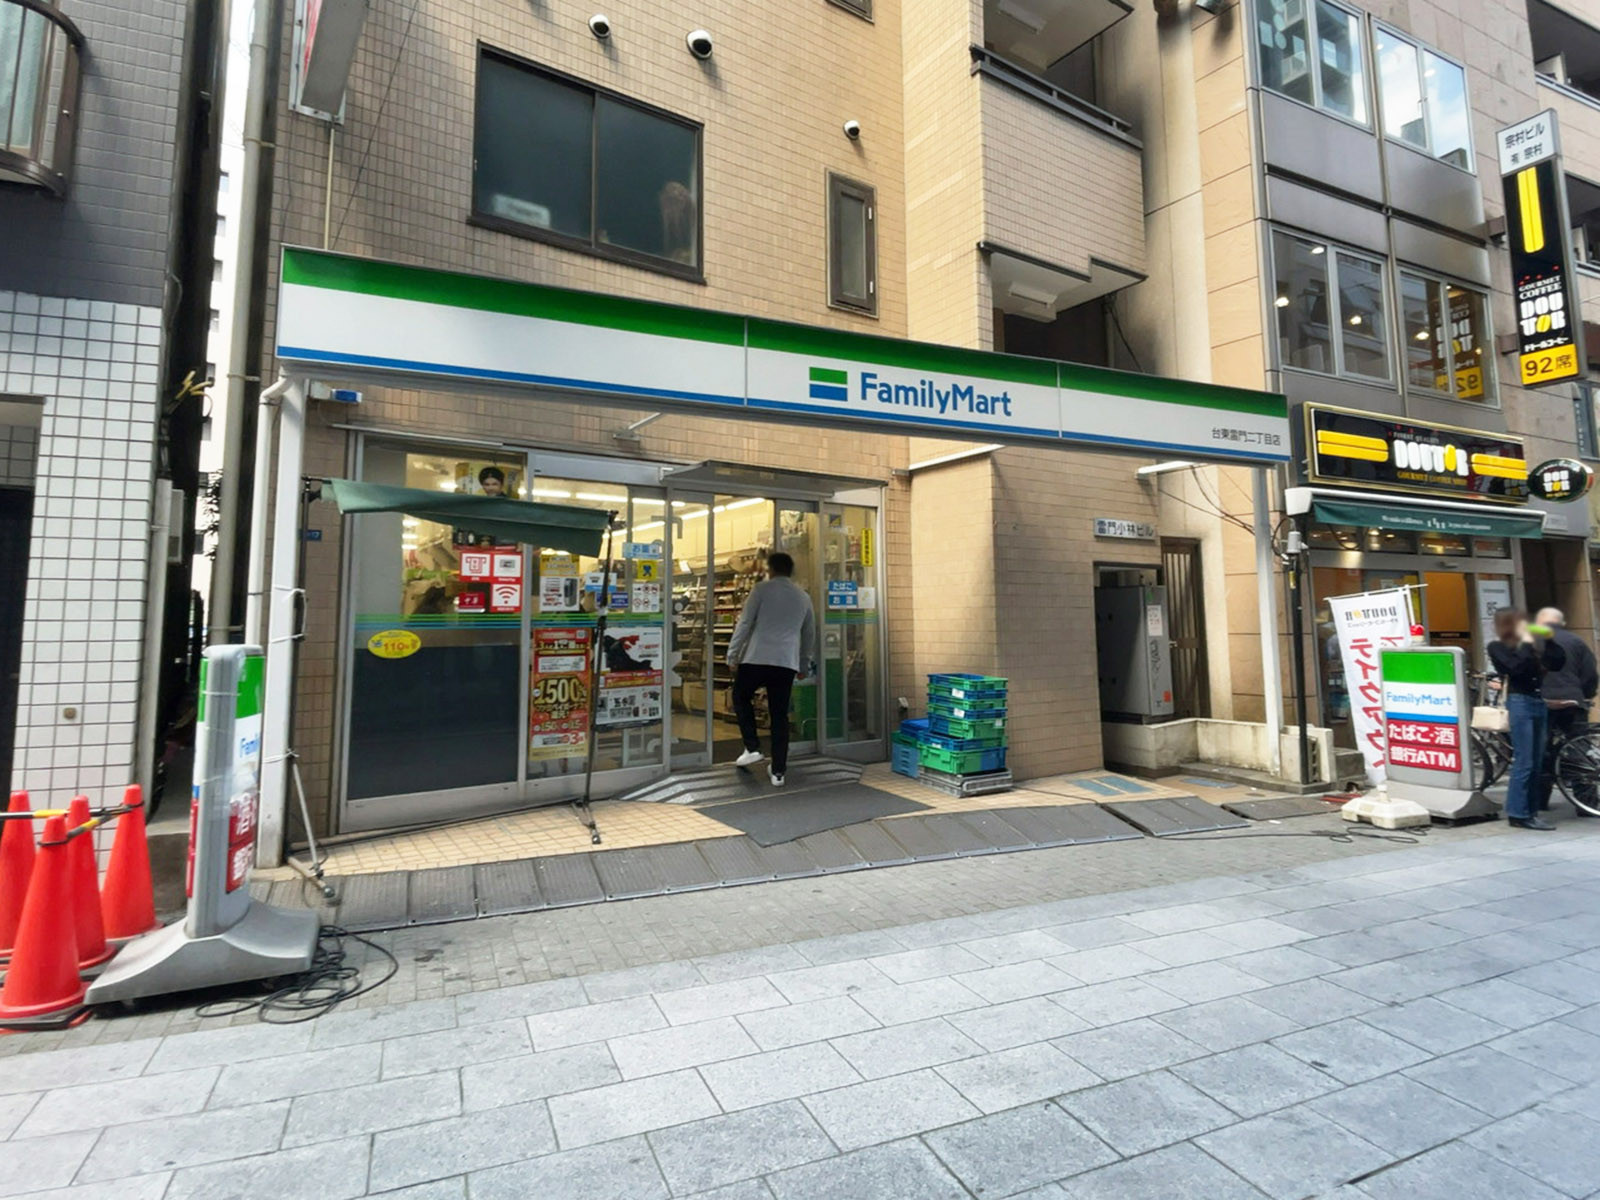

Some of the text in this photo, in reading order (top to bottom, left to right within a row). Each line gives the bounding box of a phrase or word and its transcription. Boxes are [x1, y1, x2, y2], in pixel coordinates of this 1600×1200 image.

[1518, 275, 1561, 292] GOURMET
[1519, 282, 1562, 299] COFFEE
[861, 372, 1012, 417] FamilyMart
[1393, 439, 1470, 477] DOUTOR
[1386, 691, 1452, 706] FamilyMart
[1388, 723, 1455, 746] たばこ・酒
[1390, 745, 1456, 768] 銀行ATM
